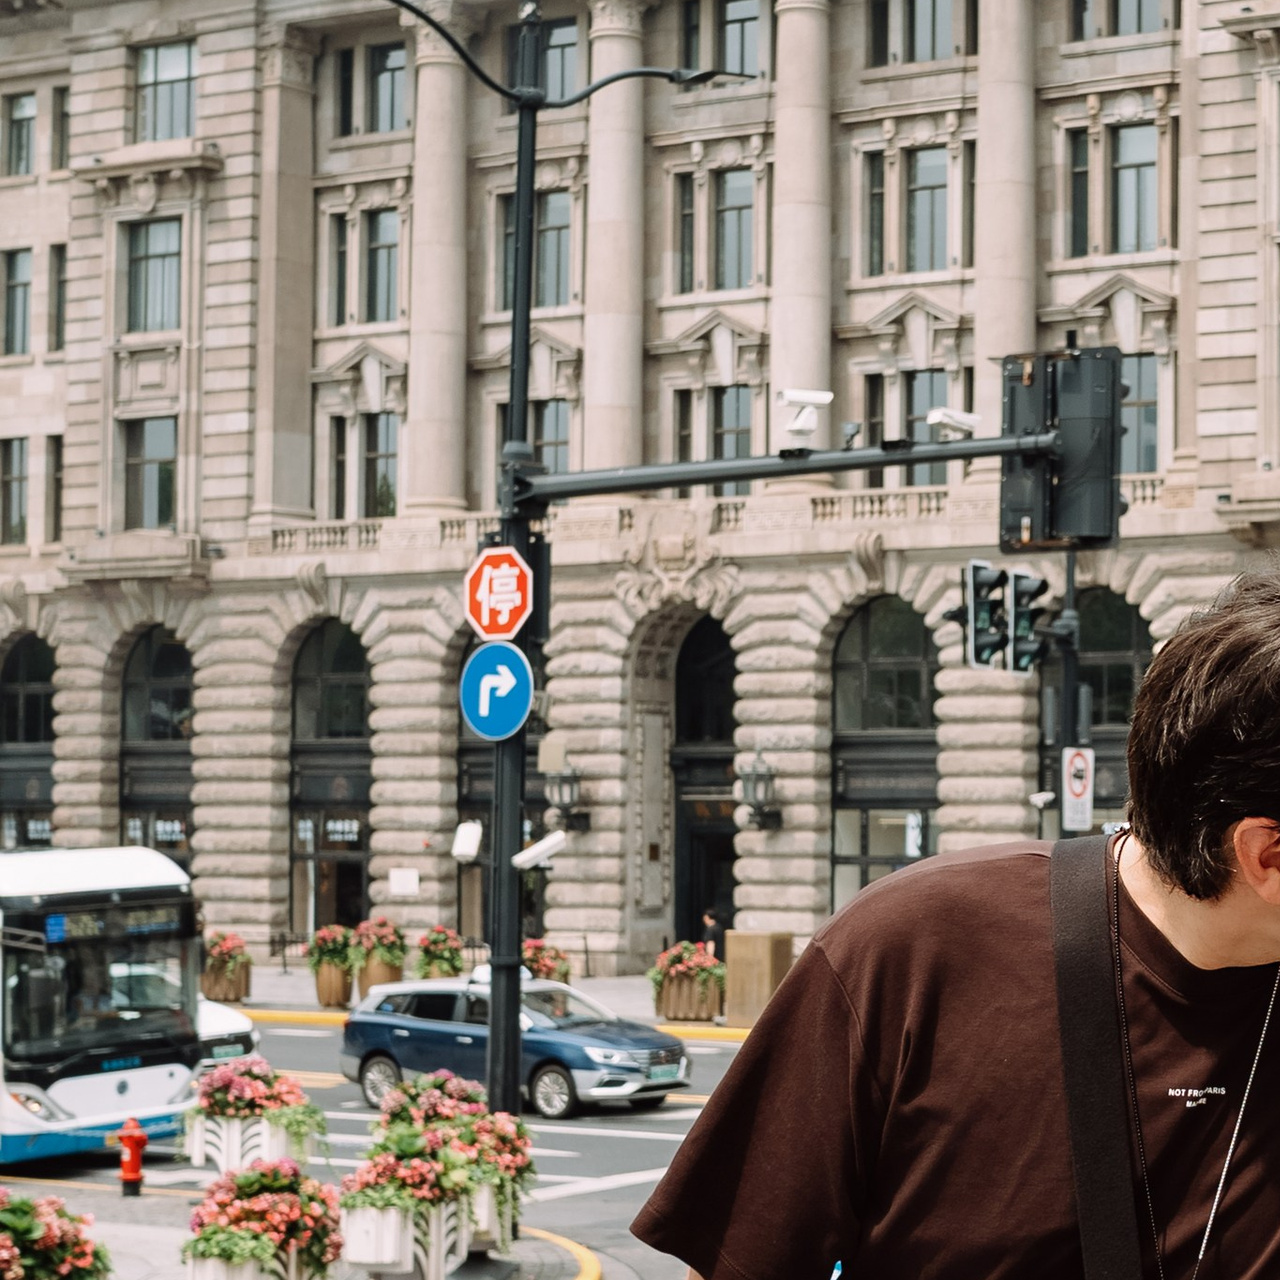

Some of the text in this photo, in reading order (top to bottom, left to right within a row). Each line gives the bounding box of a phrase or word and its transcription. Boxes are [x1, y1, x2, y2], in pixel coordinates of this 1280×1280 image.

[475, 562, 522, 626] 停
[1168, 1088, 1186, 1097] NOT
[1187, 1089, 1204, 1097] FRO
